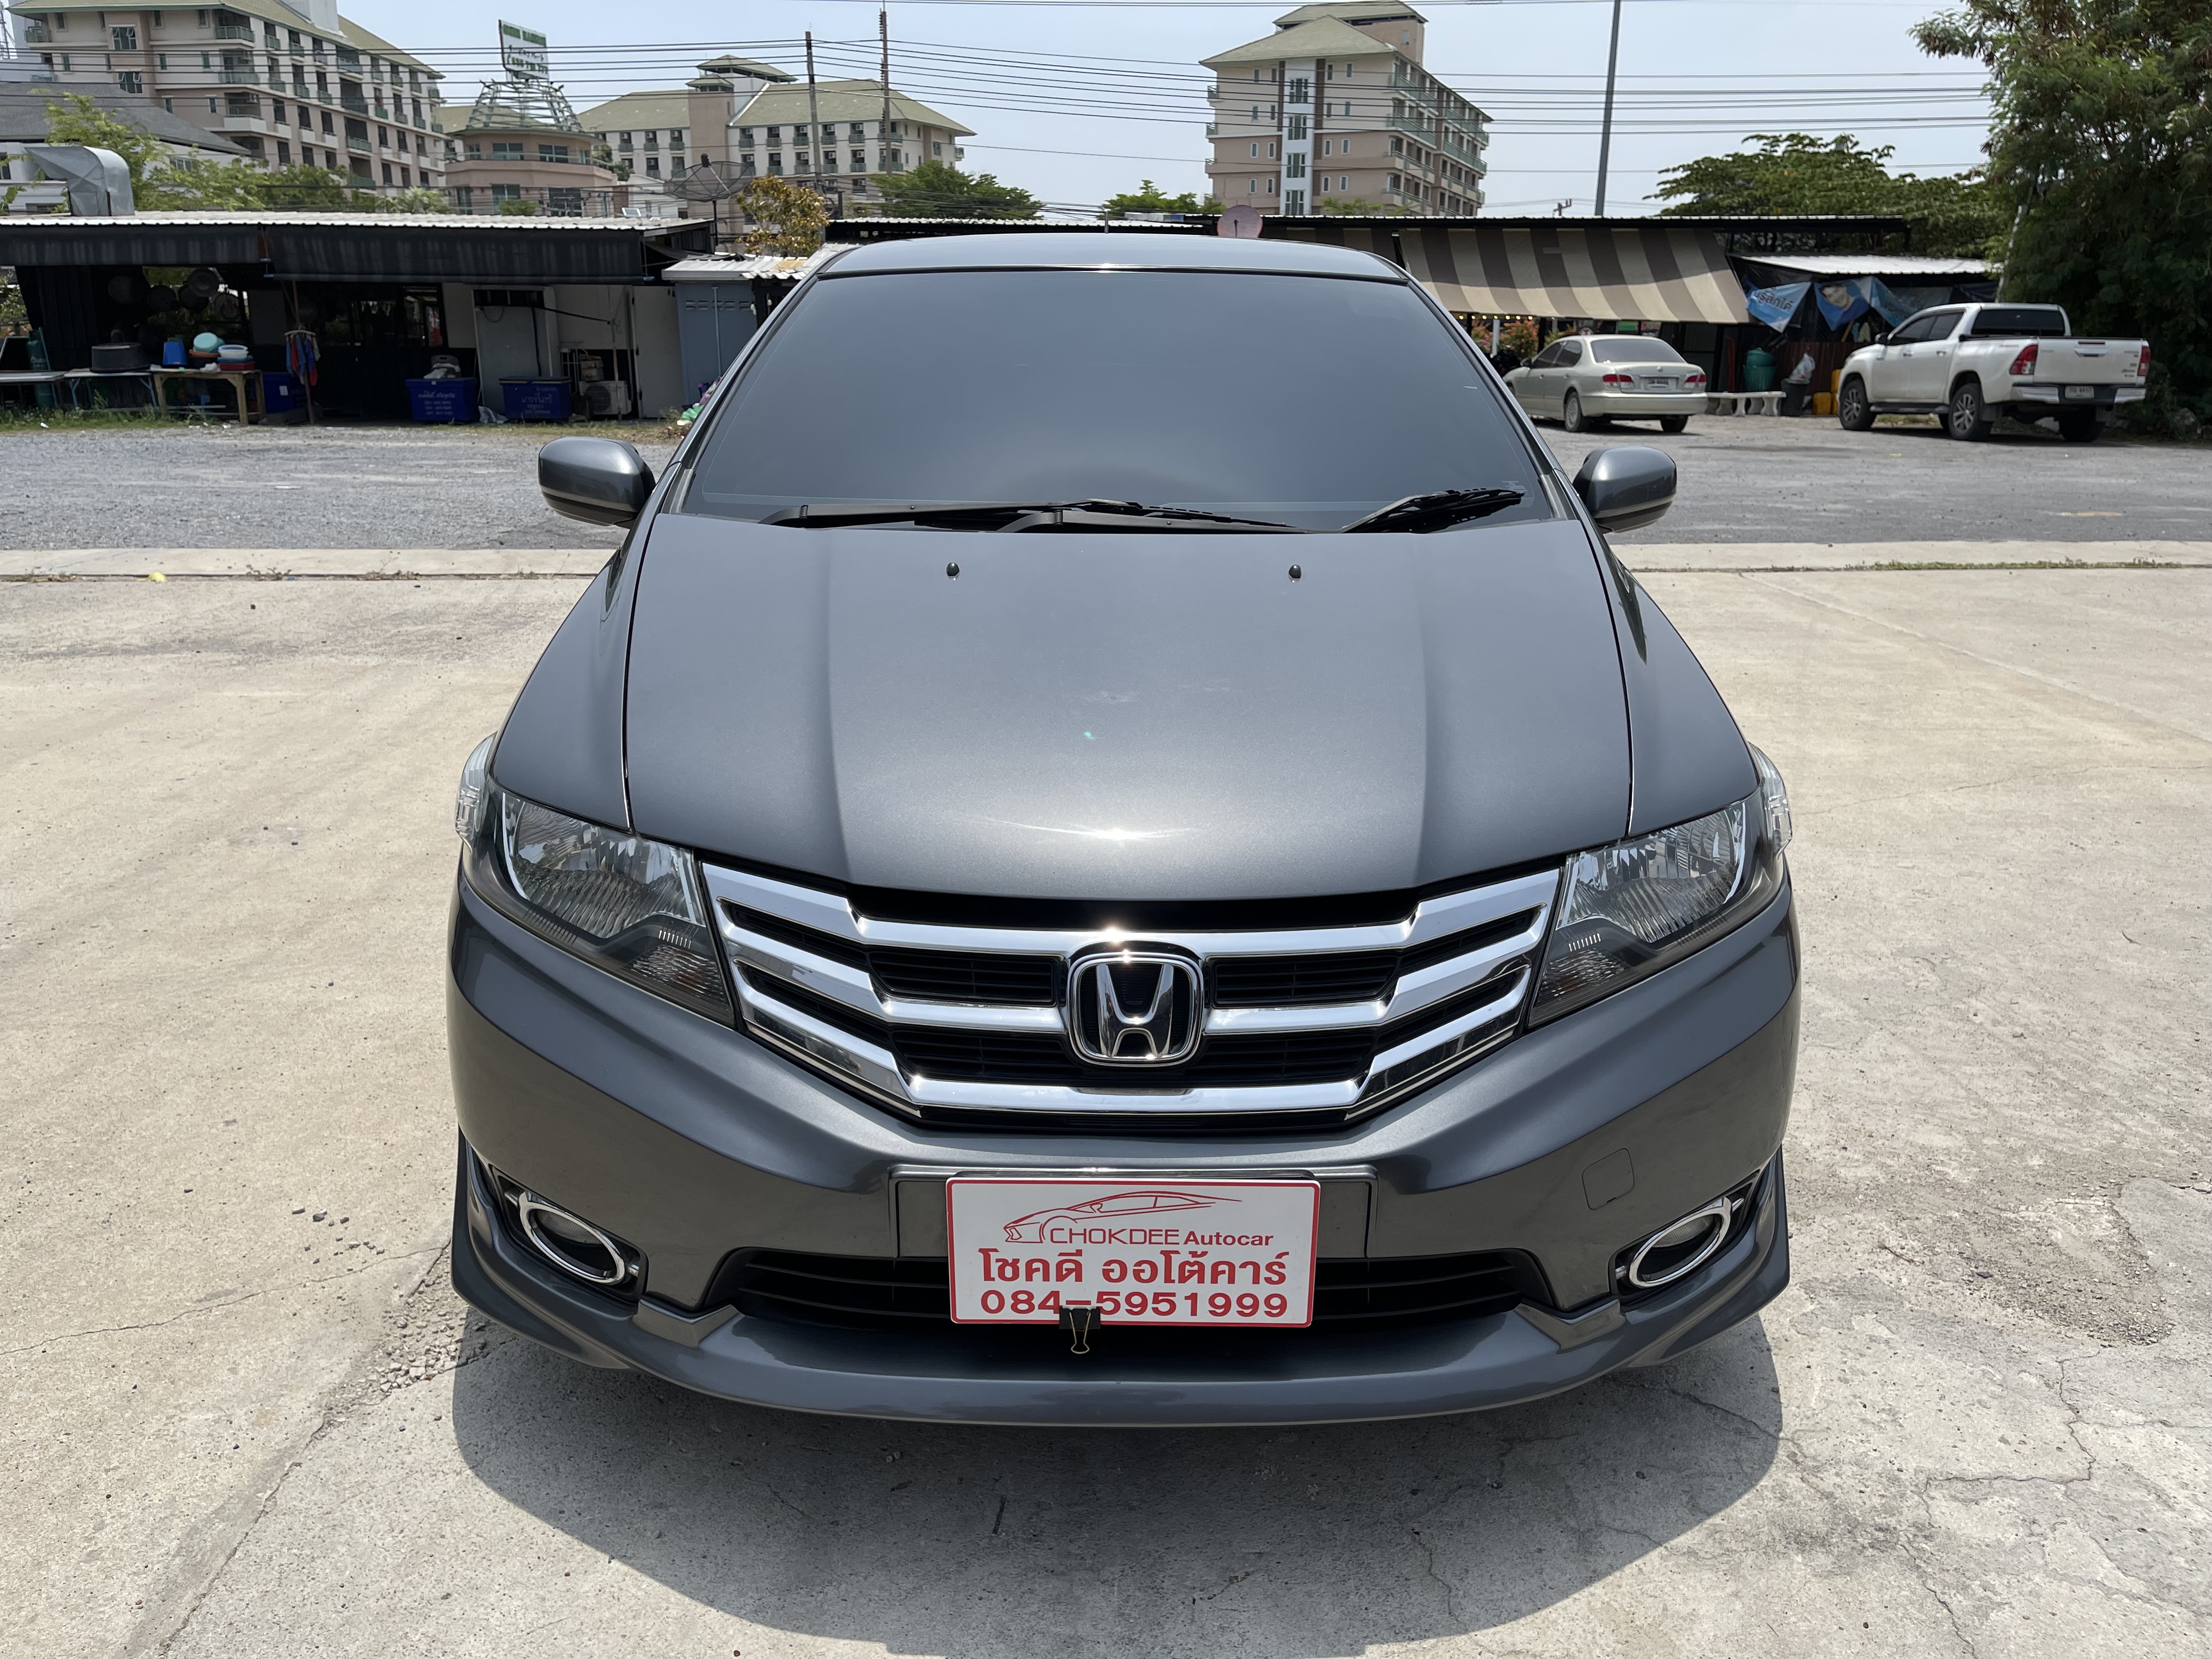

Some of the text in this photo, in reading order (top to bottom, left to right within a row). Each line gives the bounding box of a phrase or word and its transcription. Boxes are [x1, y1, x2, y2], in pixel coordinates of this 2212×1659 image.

[1049, 1227, 1274, 1246] CHOKDEE Autocar
[978, 1248, 1290, 1285] โชคดี ออโต้คาร์
[980, 1290, 1288, 1318] 084-5951999
